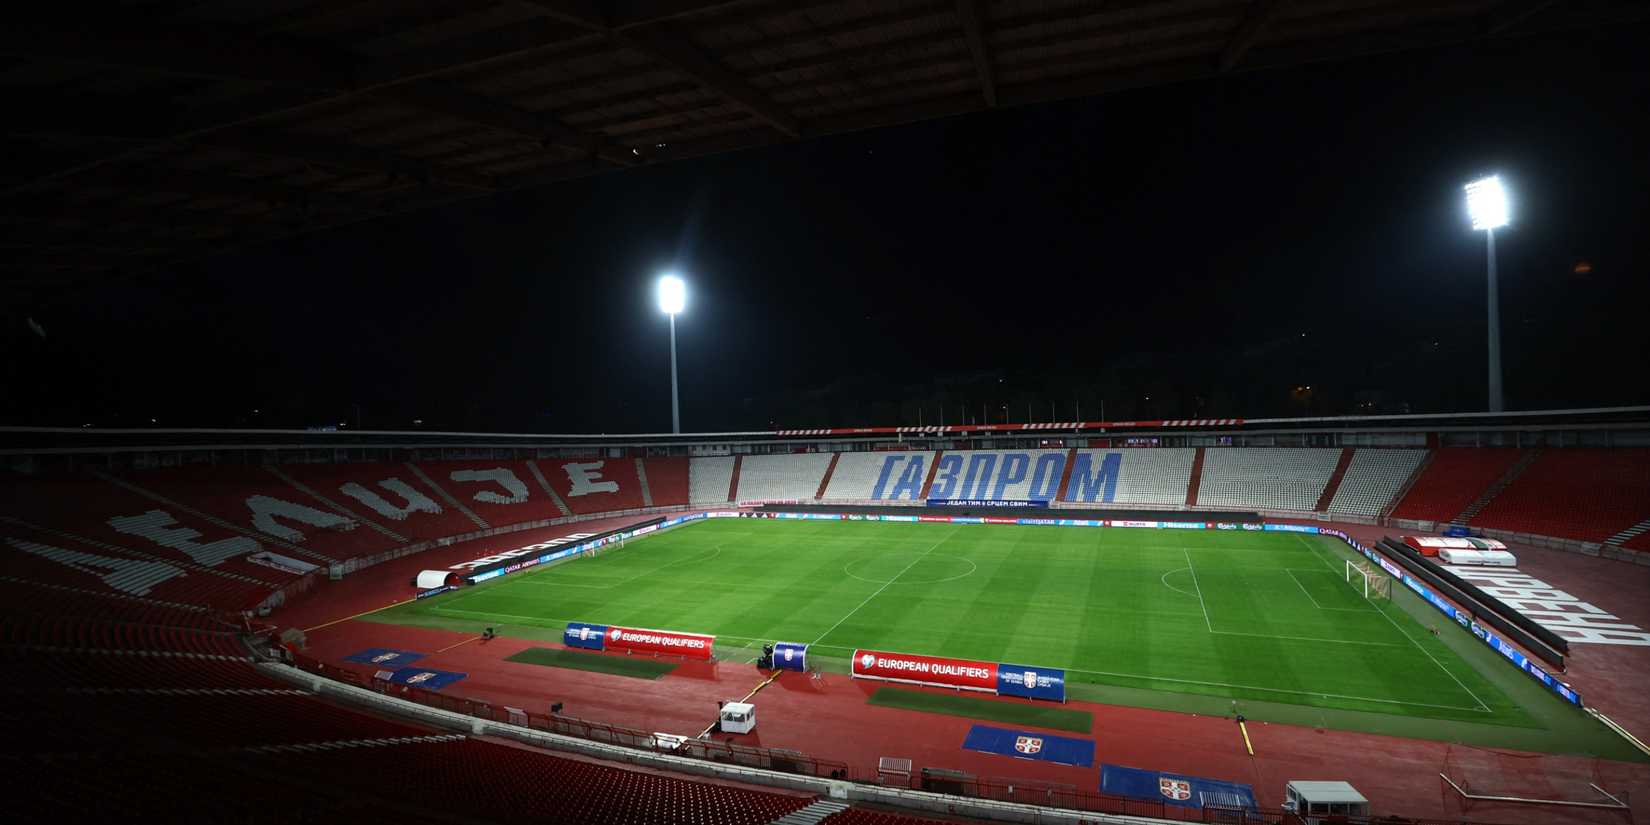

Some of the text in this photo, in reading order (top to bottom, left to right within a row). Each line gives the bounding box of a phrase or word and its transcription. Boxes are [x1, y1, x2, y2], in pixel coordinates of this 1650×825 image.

[872, 453, 1122, 503] ГАЗПРОМ
[622, 632, 705, 649] EUROPEAN QUALIFIERS
[877, 658, 929, 673] EUROPEAN
[931, 664, 989, 679] QUALIFIERS
